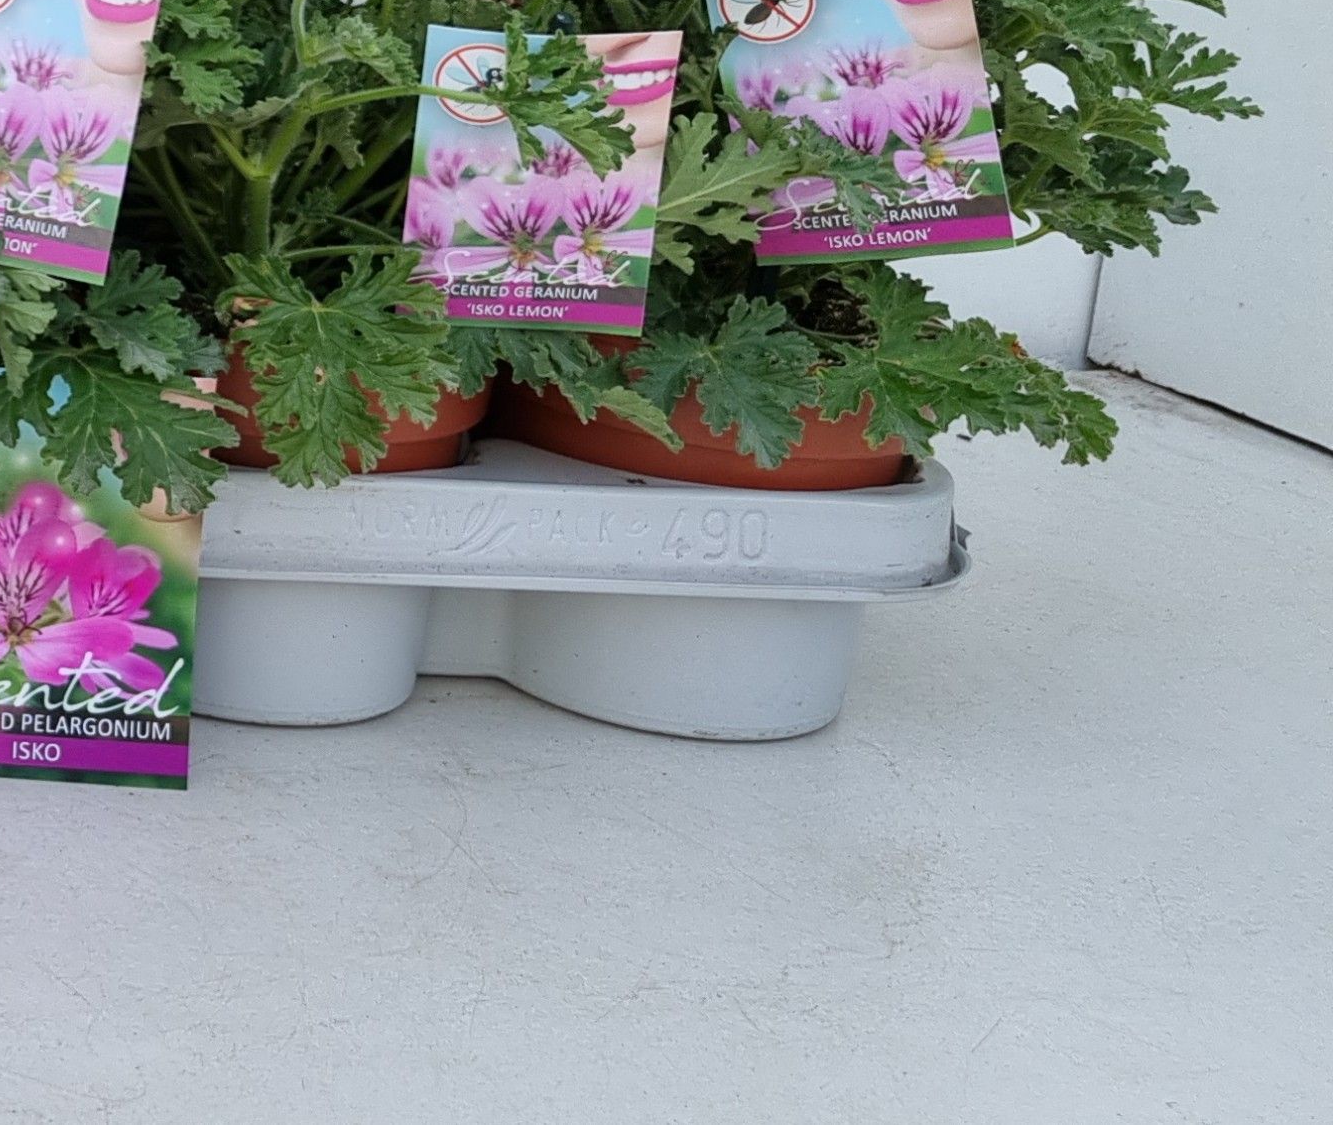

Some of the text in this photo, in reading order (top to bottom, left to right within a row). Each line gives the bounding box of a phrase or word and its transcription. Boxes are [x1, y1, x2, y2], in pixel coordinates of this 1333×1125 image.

[793, 213, 853, 230] SCENTE
[823, 226, 932, 249] 'ISKO LEMON'
[442, 283, 598, 301] SCENTED GERANIUM
[467, 303, 569, 319] 'ISKO LEMON'
[660, 507, 771, 562] 490
[20, 712, 172, 742] PELARGONIUM
[12, 741, 61, 762] ISKO
